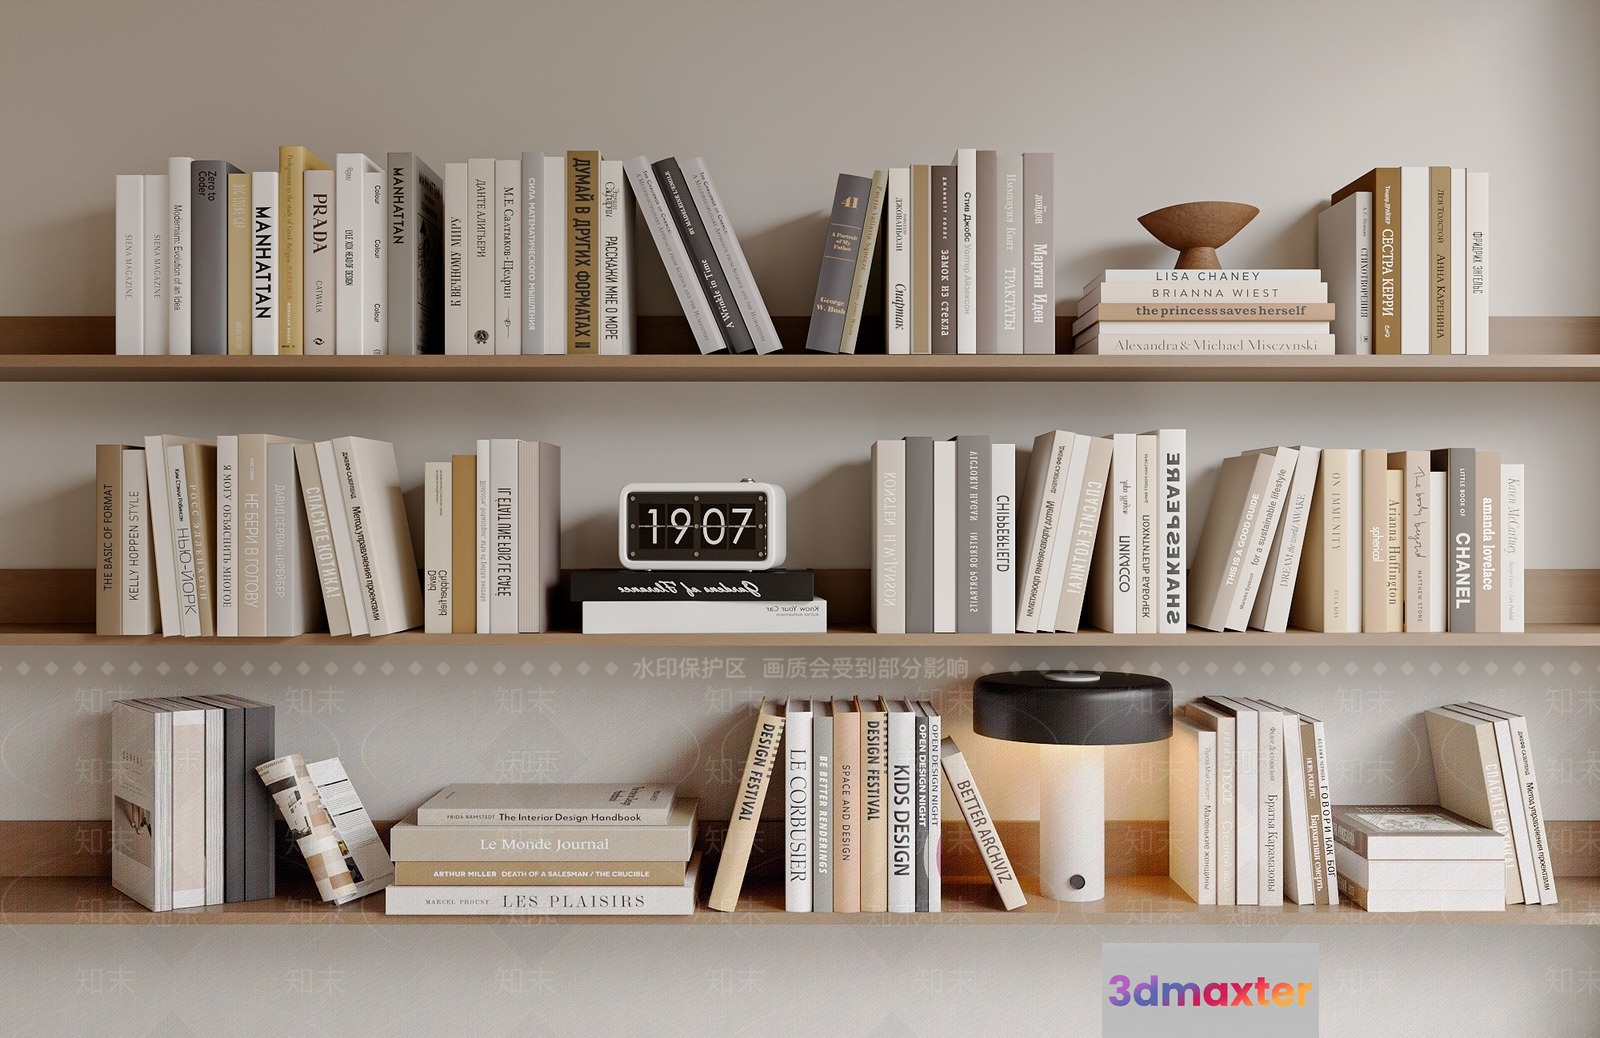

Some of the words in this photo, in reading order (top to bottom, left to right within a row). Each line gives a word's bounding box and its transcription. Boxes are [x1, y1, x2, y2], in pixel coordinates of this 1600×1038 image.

[198, 171, 207, 196] Coder
[208, 171, 217, 190] Zero
[208, 192, 214, 201] to
[475, 179, 486, 209] ДАНТЕ
[573, 158, 594, 202] ДУМАЙ
[393, 168, 404, 244] MANHATTAN
[841, 196, 859, 210] 41
[174, 205, 183, 244] Modernism:
[312, 193, 327, 254] PRADA
[451, 217, 461, 247] МИРУ
[475, 211, 486, 258] АЛИГЬЕРИ
[963, 214, 972, 242] Джобс
[174, 247, 183, 275] Evolution
[573, 219, 591, 267] ДРУГИХ
[605, 236, 617, 283] РАССКАЖИ
[1382, 228, 1394, 275] СЕСТРА
[256, 206, 271, 318] MANHATTAN
[451, 251, 461, 297] ВЕЧНОМУ
[699, 258, 714, 280] Time
[1031, 243, 1048, 288] Мартин
[1156, 272, 1190, 281] LISA
[1197, 272, 1261, 281] CHANEY
[174, 286, 180, 294] an
[315, 280, 323, 313] CATWALK
[605, 286, 617, 304] МНЕ
[708, 279, 717, 289] in
[820, 296, 845, 306] George
[1005, 268, 1015, 331] ТРАКТАТЫ
[1152, 289, 1224, 298] BRIANNA
[1232, 289, 1279, 298] WIEST
[1360, 248, 1368, 318] СТИХОТВОРЕНИЯ
[1382, 278, 1394, 316] КЕРРИ
[174, 297, 183, 311] Idea
[575, 270, 591, 337] ФОРМАТАХ
[711, 289, 731, 321] Wrinkle
[828, 305, 846, 315] Bush
[891, 283, 906, 330] Спартак
[1032, 293, 1048, 323] Иден
[1136, 306, 1159, 315] the
[1160, 306, 1218, 318] princess
[1219, 307, 1257, 315] saves
[1258, 305, 1307, 315] herself
[605, 316, 617, 340] МОРЕ
[726, 321, 734, 329] A
[1114, 339, 1179, 351] Alexandra
[1180, 341, 1191, 351] &
[1193, 339, 1243, 351] Michael
[1247, 339, 1318, 353] Misczynski
[223, 474, 231, 501] МОГУ
[1332, 472, 1341, 486] ON
[104, 484, 112, 523] FORMAT
[129, 491, 139, 521] STYLE
[245, 494, 258, 509] НЕ
[306, 486, 330, 542] СПАСИТЕ
[1251, 554, 1259, 565] for
[1258, 500, 1277, 546] sustainable
[1271, 468, 1287, 499] lifestyle
[1460, 509, 1465, 517] OF
[104, 526, 112, 539] OF
[223, 504, 231, 564] ОБЪЯСНИТЬ
[245, 512, 258, 544] БЕРИ
[647, 508, 753, 545] 1907
[1332, 493, 1341, 551] IMMUNITY
[1389, 500, 1400, 541] Arianna
[1483, 498, 1492, 542] amanda
[104, 542, 112, 570] BASIC
[129, 525, 139, 566] HOPPEN
[1226, 567, 1238, 585] THIS
[1233, 557, 1240, 566] IS
[1238, 523, 1250, 548] GOOD
[1247, 493, 1259, 520] GUIDE
[1370, 526, 1384, 563] spherical
[104, 576, 112, 590] THE
[129, 569, 139, 601] KELLY
[177, 527, 197, 615] НЬЮ-ЙОРК
[245, 559, 258, 608] ГОЛОВУ
[317, 543, 341, 598] КОТИКА!
[1387, 546, 1401, 605] Huffington
[1456, 533, 1470, 609] CHANEL
[1483, 545, 1495, 591] lovelace
[223, 566, 231, 607] МНОГОЕ
[753, 723, 775, 767] DESIGN
[790, 749, 806, 771] LE
[867, 721, 879, 765] DESIGN
[819, 756, 828, 768] BE
[842, 765, 850, 795] SPACE
[739, 771, 763, 821] FESTIVAL
[819, 771, 828, 806] BETTER
[867, 769, 879, 821] FESTIVAL
[894, 765, 909, 806] KIDS
[499, 813, 516, 822] The
[518, 813, 553, 822] Interior
[555, 813, 588, 823] Design
[591, 813, 641, 822] Handbook
[842, 800, 850, 820] AND
[1265, 794, 1277, 829] Братья
[1320, 785, 1331, 833] ГОВОРИ
[480, 839, 497, 850] Le
[502, 839, 552, 850] Monde
[556, 839, 609, 852] Journal
[789, 776, 807, 882] CORBUSIER
[819, 809, 828, 873] RENDERINGS
[842, 825, 850, 861] DESIGN
[894, 815, 909, 876] DESIGN
[957, 780, 987, 828] BETTER
[978, 829, 1012, 884] ARCHVIZ
[1324, 836, 1333, 856] КАК
[1265, 831, 1277, 892] Карамазовы
[1328, 859, 1336, 877] БОГ
[503, 895, 538, 908] LES
[549, 895, 645, 908] PLAISIRS
